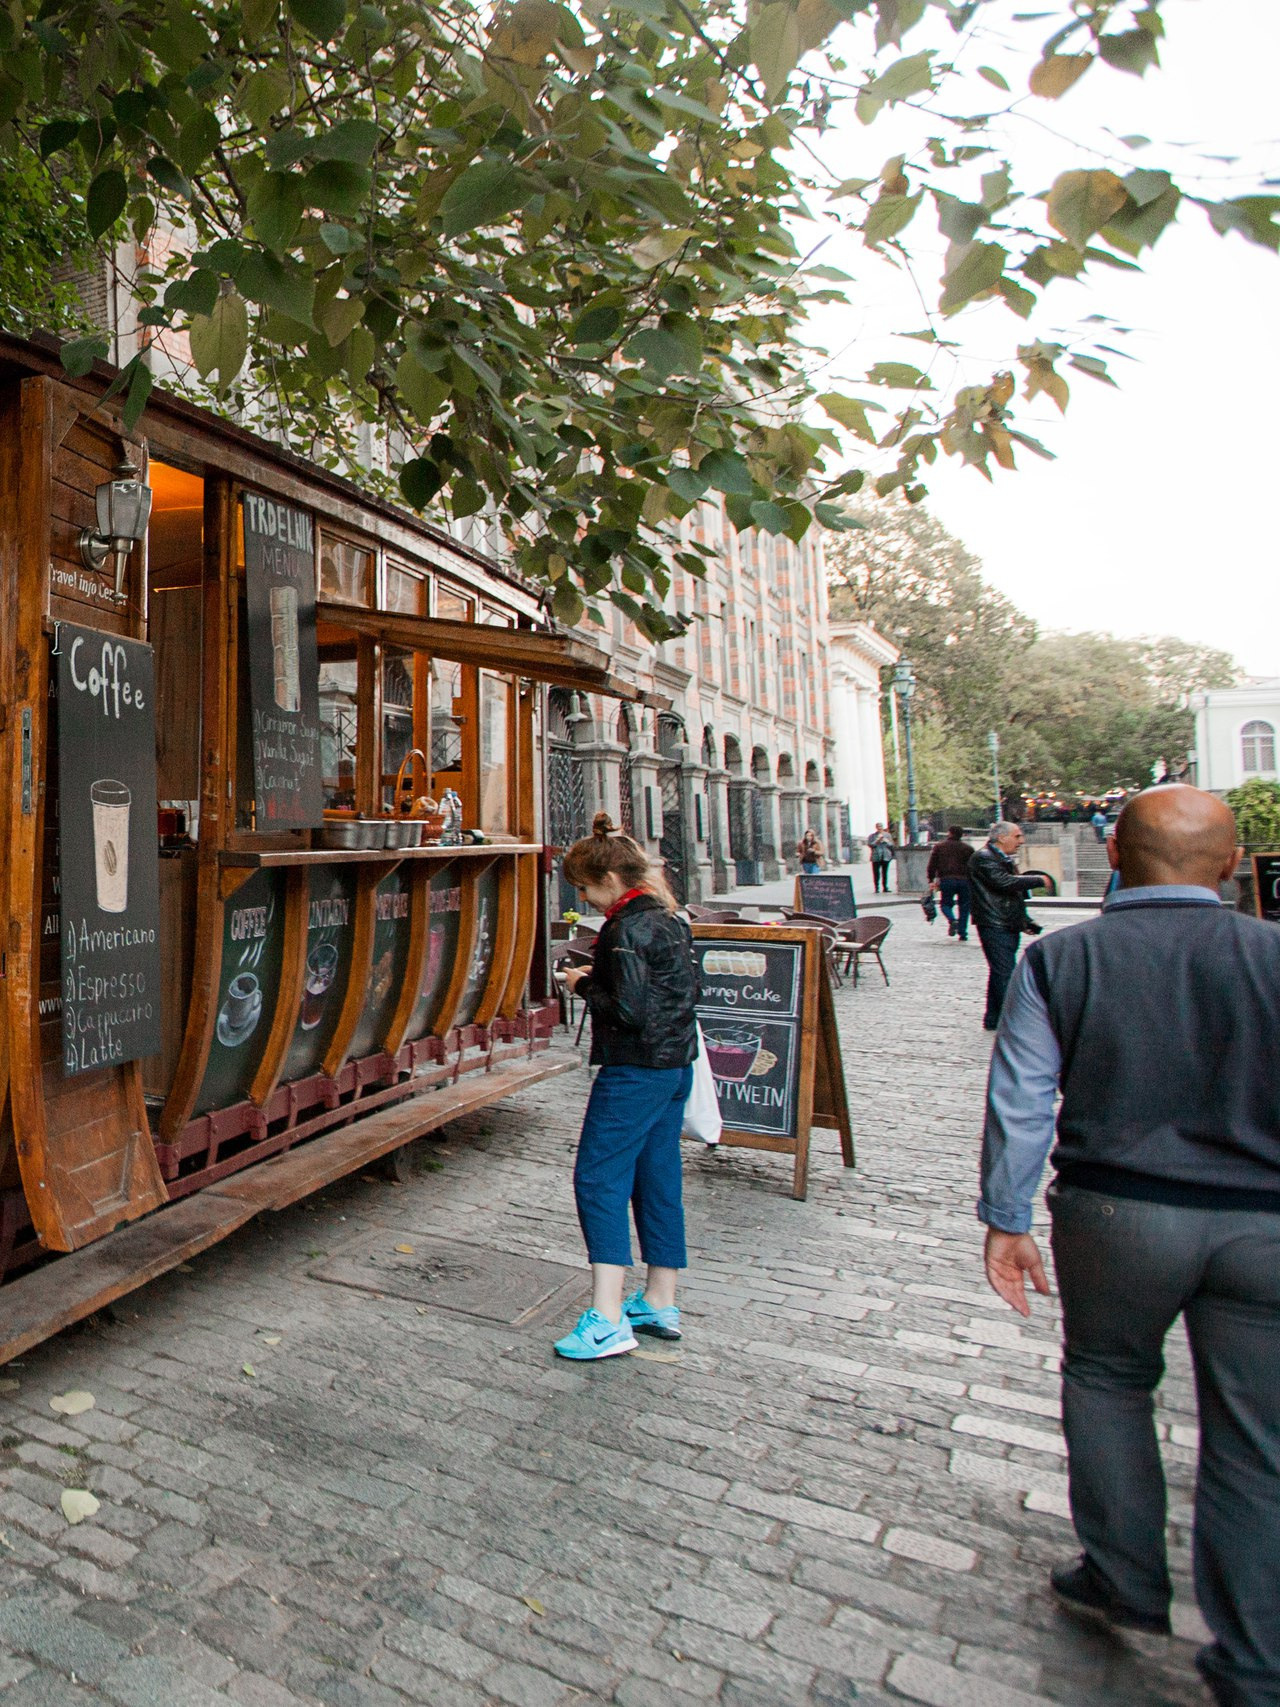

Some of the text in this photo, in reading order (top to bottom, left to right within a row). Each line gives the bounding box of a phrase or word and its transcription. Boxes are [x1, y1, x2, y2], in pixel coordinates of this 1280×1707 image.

[246, 494, 314, 554] TRDELNIK
[50, 564, 77, 587] ravel
[79, 574, 97, 598] info
[70, 636, 145, 719] Coffee
[231, 906, 267, 941] COFFEE
[742, 984, 782, 1002] Cake
